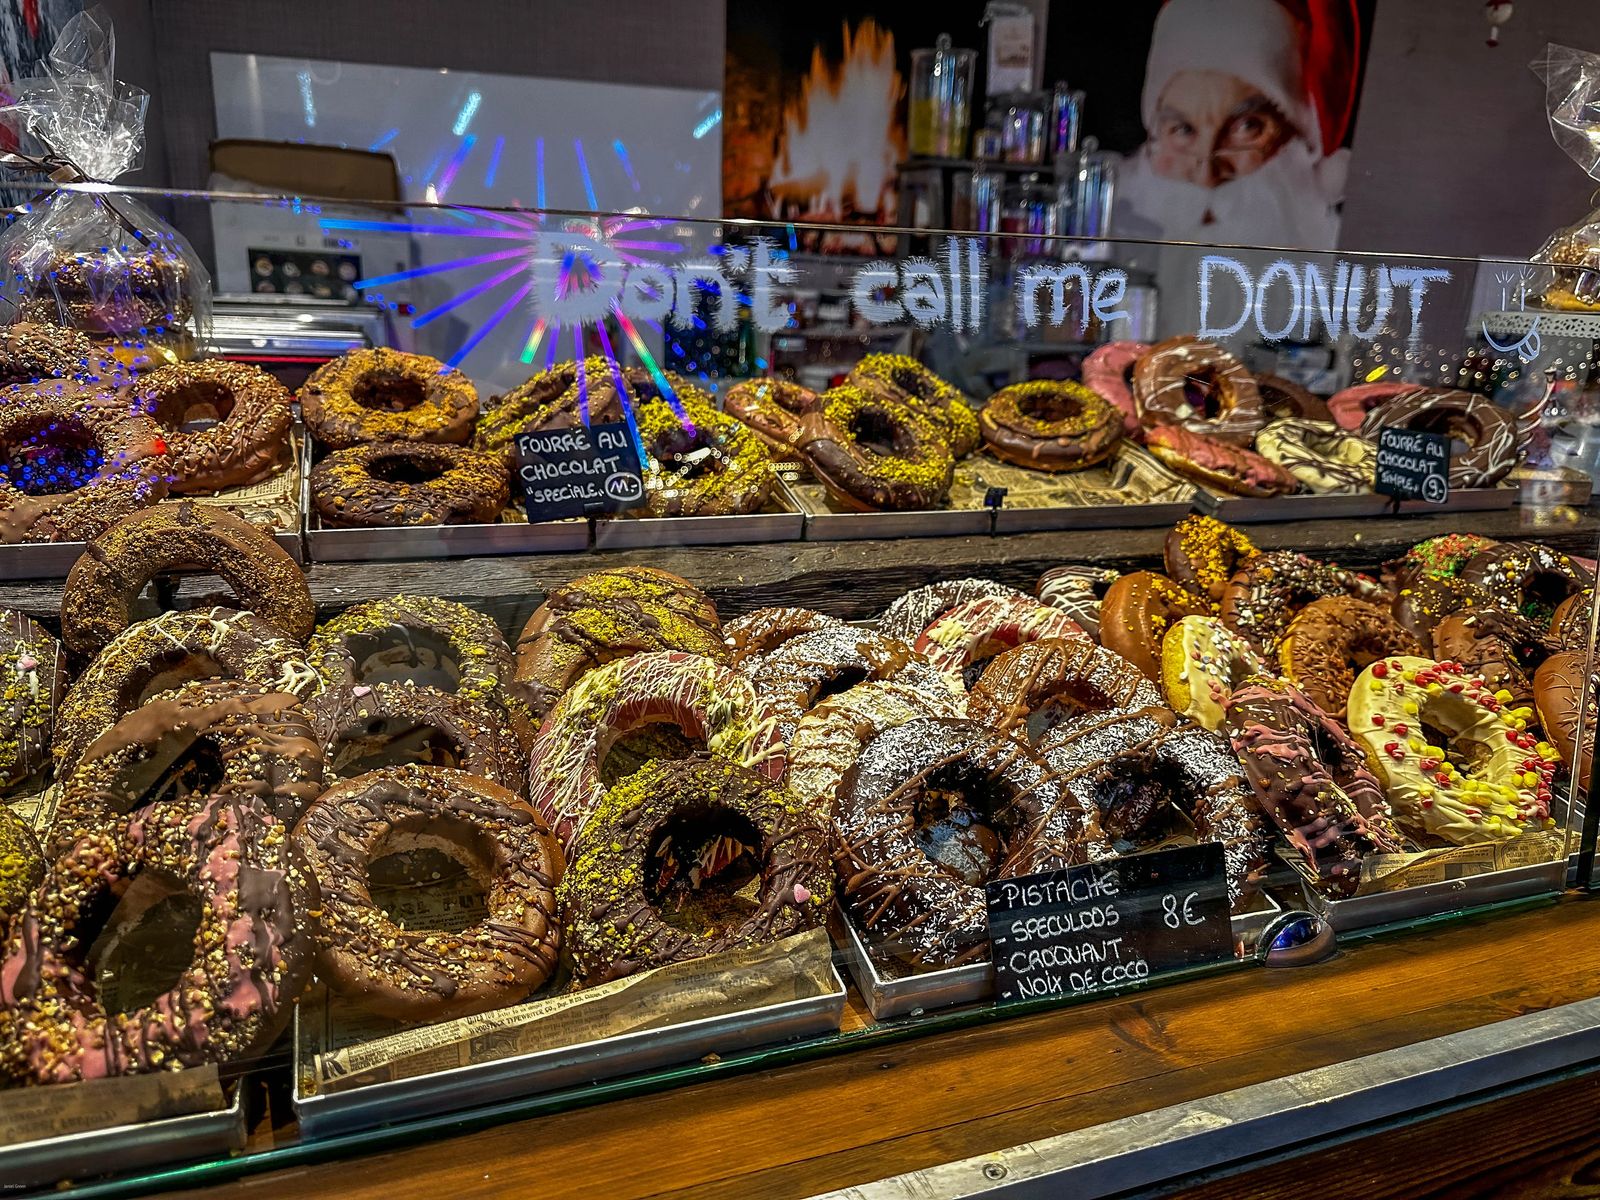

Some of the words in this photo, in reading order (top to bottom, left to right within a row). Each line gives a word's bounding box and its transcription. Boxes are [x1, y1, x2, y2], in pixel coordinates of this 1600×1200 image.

[531, 231, 797, 333] Don't
[853, 236, 988, 334] call
[1018, 262, 1131, 334] me
[1198, 255, 1453, 350] DONUT
[519, 429, 591, 456] FOURRÉ
[598, 430, 628, 449] AU
[1380, 429, 1423, 452] FOURRÉ
[1426, 442, 1444, 457] AU
[520, 455, 620, 481] CHOCOLAT
[1377, 449, 1438, 473] CHOCOLAT
[1001, 870, 1119, 908] PISTACHE
[1011, 904, 1120, 942] SPECULOOS
[1162, 891, 1206, 928] 8€
[1010, 937, 1123, 973] CROQUANT
[1070, 968, 1098, 991] DE
[1101, 960, 1149, 984] COCO
[506, 1008, 544, 1025] TYPEWRITER
